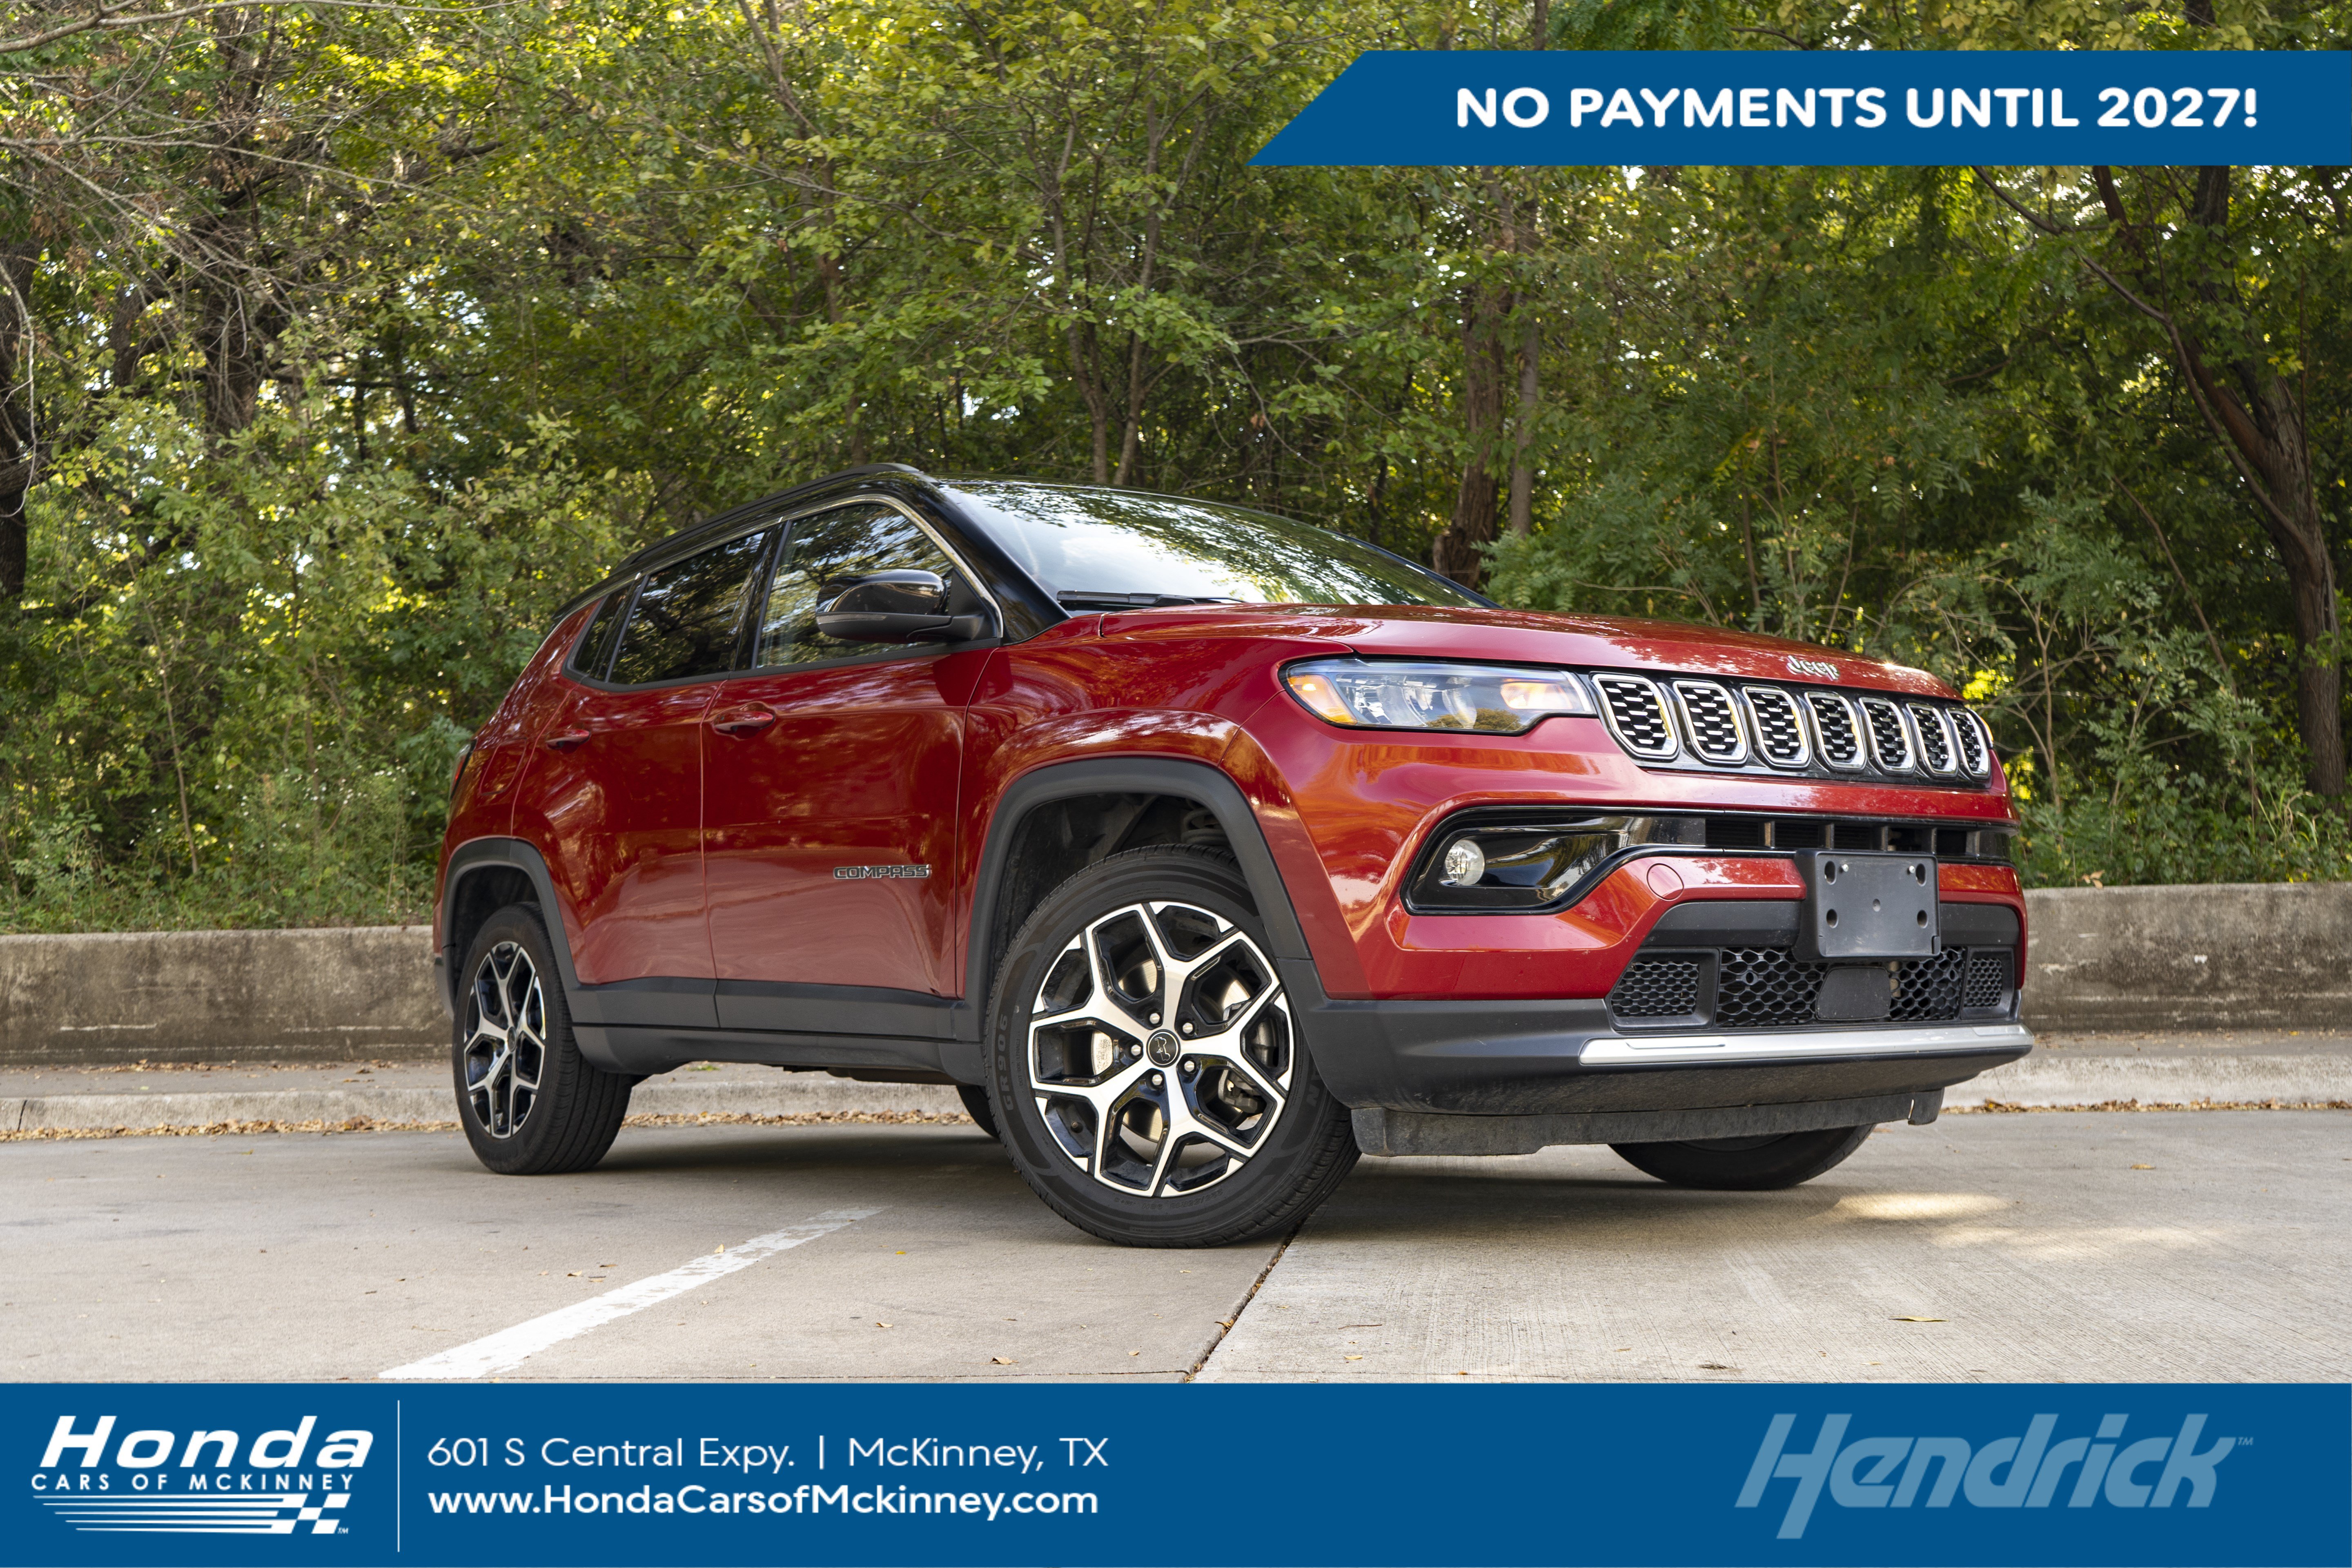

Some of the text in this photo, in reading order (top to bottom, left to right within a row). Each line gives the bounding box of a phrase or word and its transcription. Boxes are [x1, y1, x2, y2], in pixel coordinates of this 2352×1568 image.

[1786, 655, 1839, 681] Jeep
[833, 864, 931, 879] COMPASS
[998, 1013, 1014, 1111] GR906
